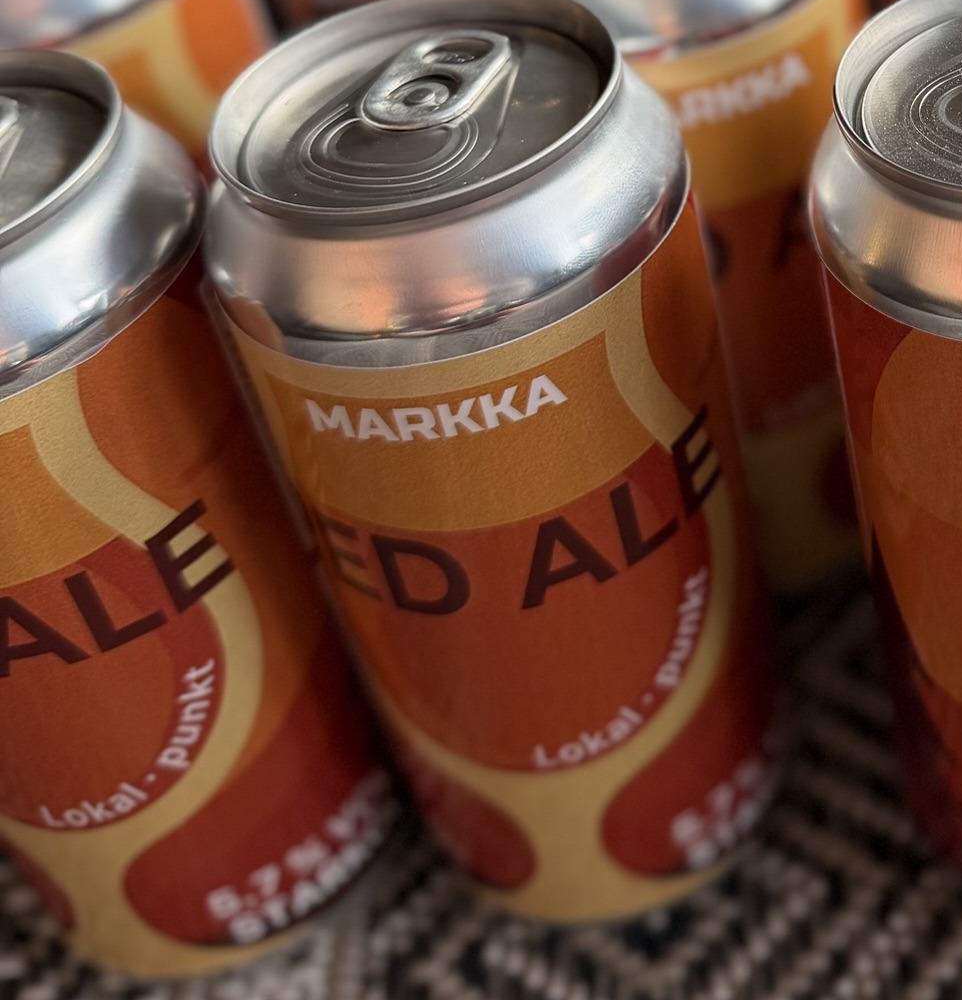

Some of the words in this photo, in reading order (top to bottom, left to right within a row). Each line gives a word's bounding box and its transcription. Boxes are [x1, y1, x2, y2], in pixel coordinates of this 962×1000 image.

[305, 374, 568, 442] MARKKA
[0, 500, 236, 677] ALE
[320, 511, 471, 616] ED
[521, 405, 722, 610] ALE
[42, 782, 149, 830] Lokal
[161, 658, 216, 771] punkt
[533, 707, 642, 769] Lokal
[655, 567, 709, 690] punkt
